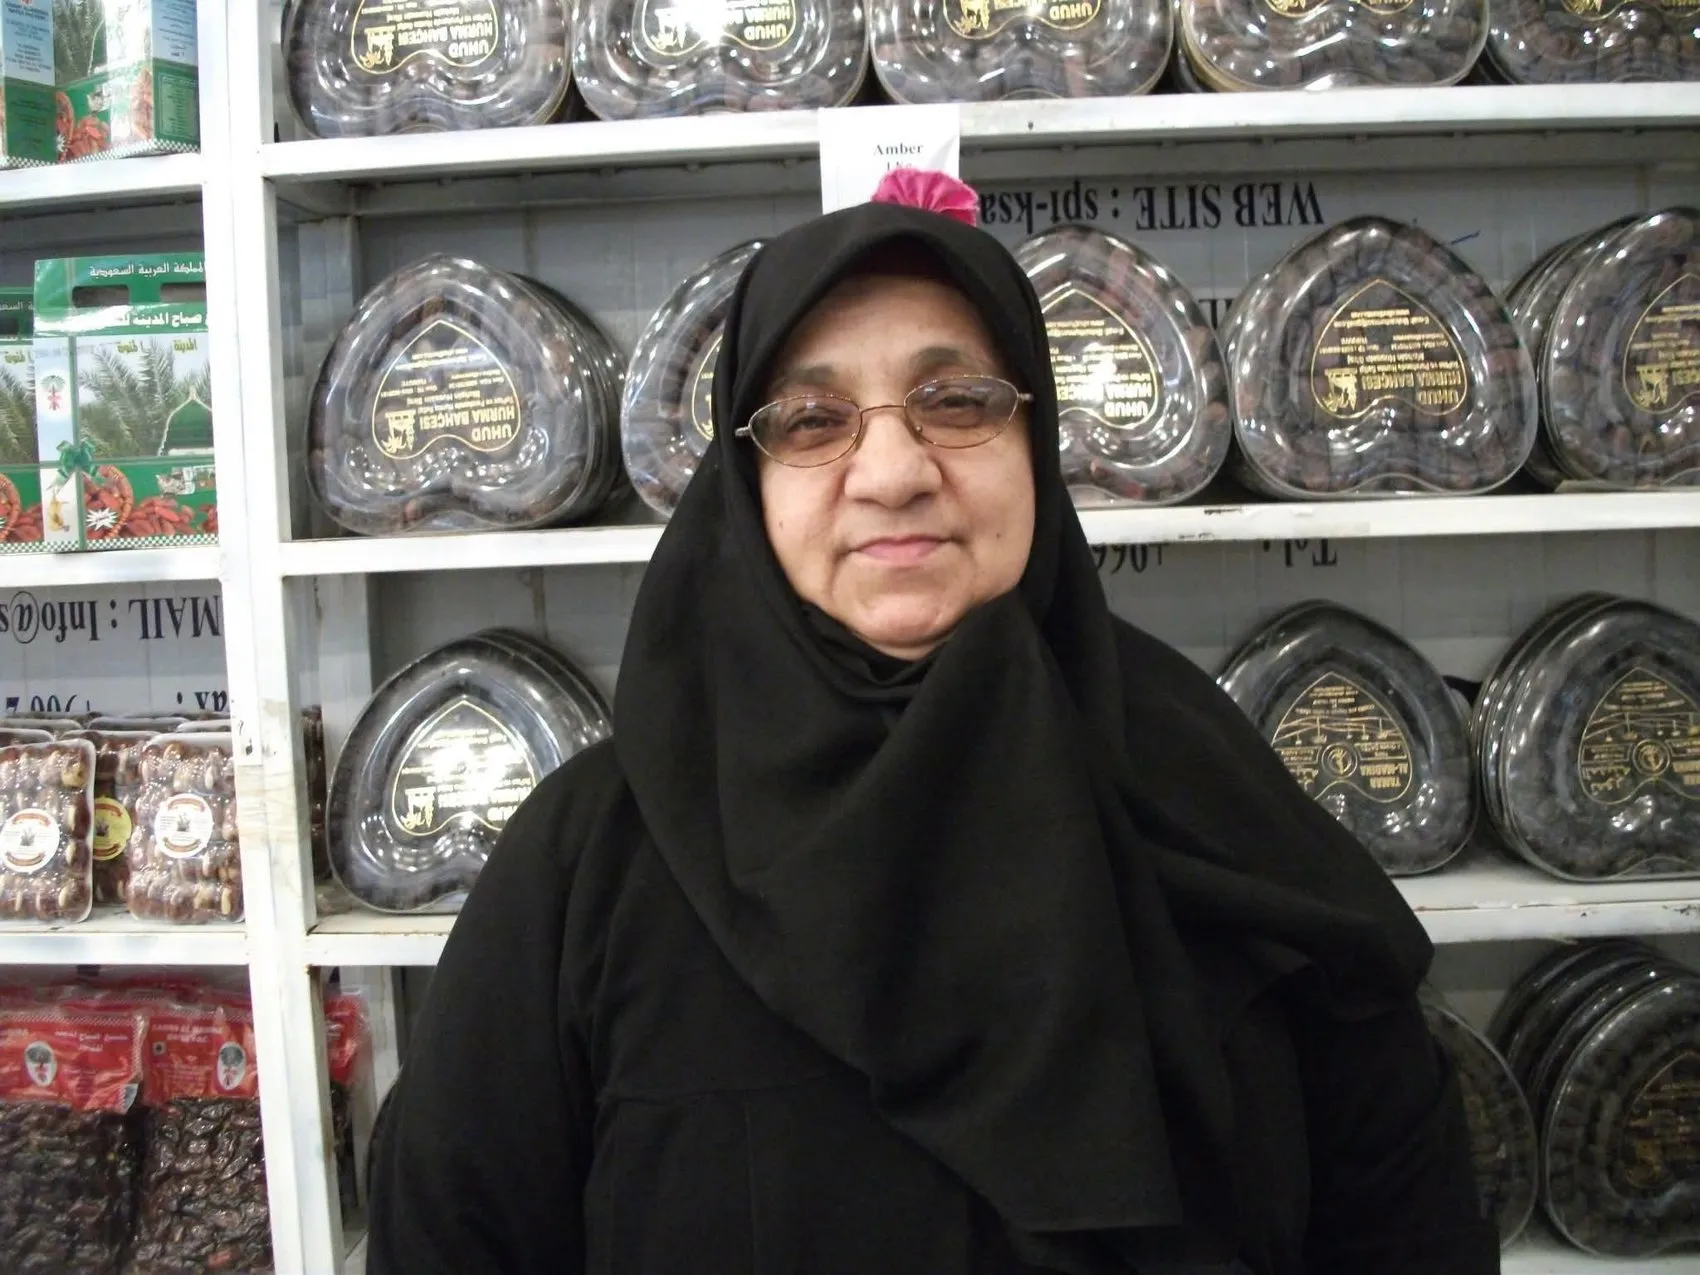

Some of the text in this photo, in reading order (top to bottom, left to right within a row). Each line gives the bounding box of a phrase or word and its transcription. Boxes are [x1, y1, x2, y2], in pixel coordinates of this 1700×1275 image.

[1049, 3, 1093, 20] UHUD
[744, 24, 787, 41] UHUD
[448, 39, 489, 58] UHUD
[873, 142, 924, 156] Amber
[1133, 185, 1222, 231] SITE
[1233, 181, 1325, 227] WEB
[472, 405, 516, 424] HURMA
[1104, 401, 1148, 418] UHUD
[471, 424, 512, 442] UHUD
